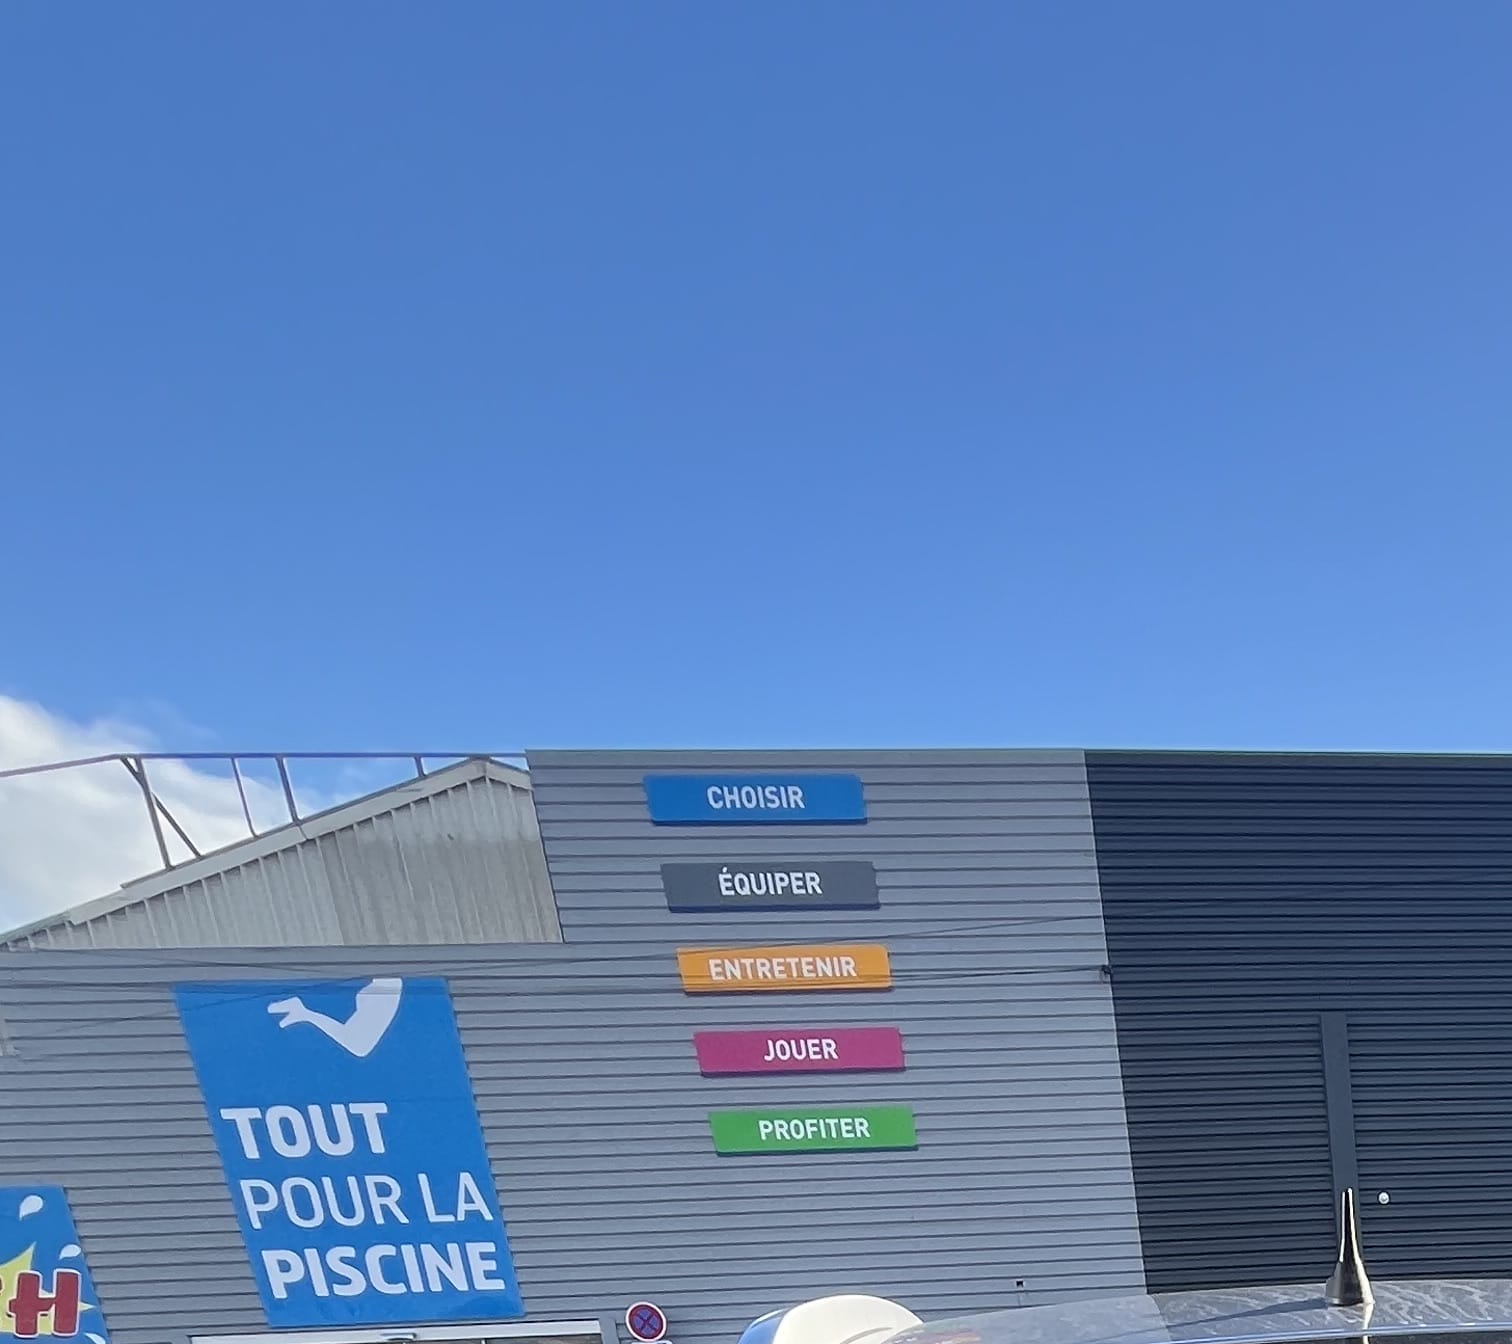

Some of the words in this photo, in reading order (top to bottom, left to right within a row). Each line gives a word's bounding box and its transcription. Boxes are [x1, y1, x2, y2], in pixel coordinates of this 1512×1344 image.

[707, 786, 805, 810] CHOISIR
[718, 866, 823, 896] ÉQUIPER
[708, 956, 857, 980] ENTRETENIR
[764, 1038, 838, 1062] JOUER
[219, 1102, 388, 1160] TOUT
[759, 1118, 871, 1140] PROFITER
[239, 1175, 409, 1230] POUR
[419, 1172, 494, 1223] LA
[261, 1241, 505, 1299] PISCINE
[0, 1268, 81, 1338] H
